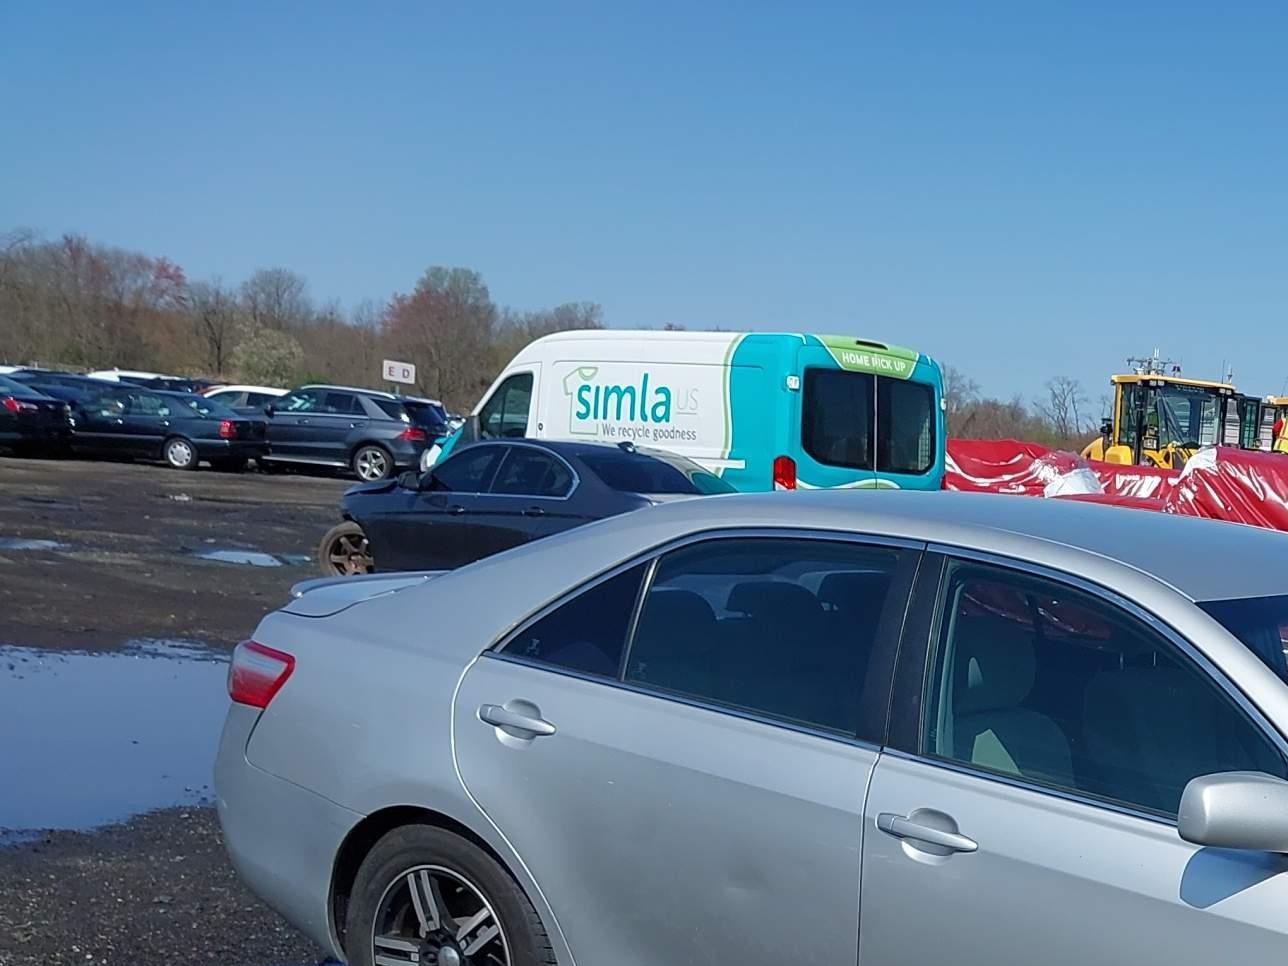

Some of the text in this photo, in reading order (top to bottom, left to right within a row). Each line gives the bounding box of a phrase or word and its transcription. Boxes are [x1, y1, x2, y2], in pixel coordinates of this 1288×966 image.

[842, 352, 870, 367] HOME
[894, 361, 906, 372] UP
[402, 368, 410, 379] D
[575, 372, 672, 423] simla
[602, 422, 697, 441] We recycle goodness
